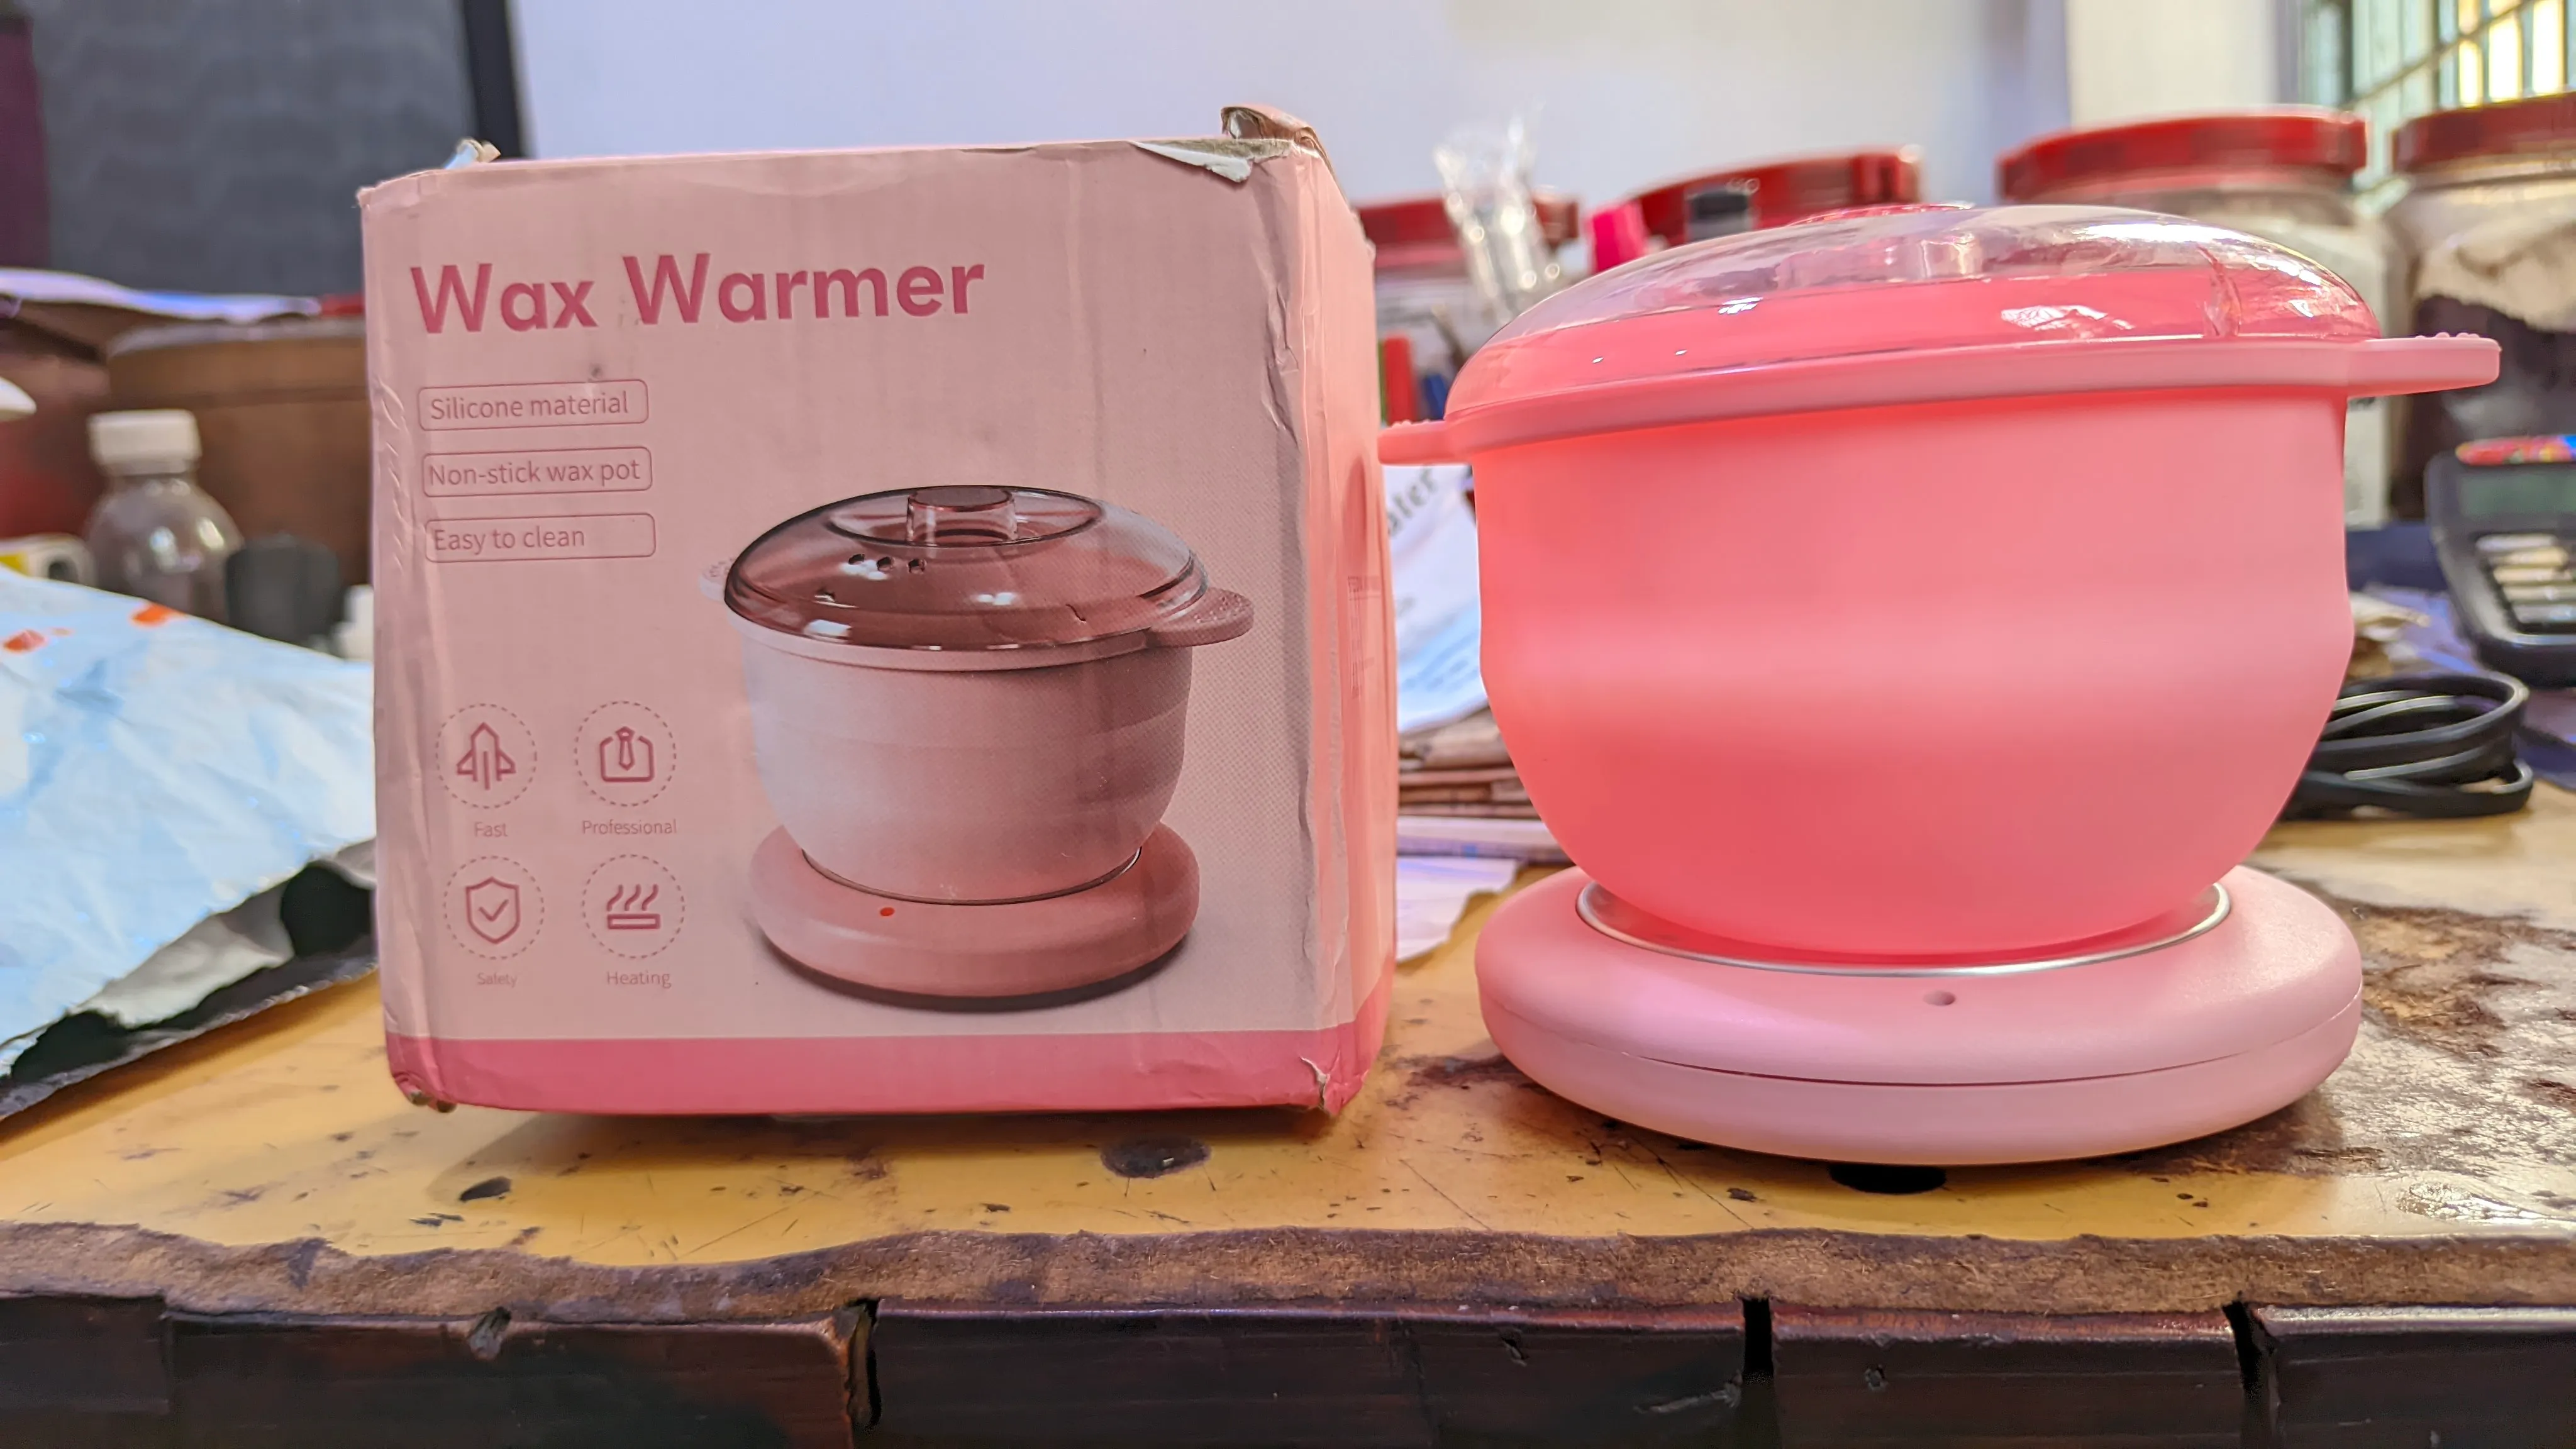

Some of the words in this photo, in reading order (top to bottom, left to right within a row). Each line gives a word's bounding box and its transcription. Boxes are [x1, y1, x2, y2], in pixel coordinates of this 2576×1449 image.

[410, 264, 597, 333] Wax
[623, 253, 984, 325] Warmer
[430, 397, 523, 420] Silicone
[530, 391, 628, 416] material
[428, 461, 541, 486] Non-stick
[547, 466, 594, 482] wax
[601, 460, 641, 487] pot
[434, 528, 486, 554] Easy
[493, 529, 516, 549] to
[523, 525, 585, 548] clean
[474, 822, 508, 837] Fast
[582, 819, 677, 835] Professional
[477, 972, 518, 988] Safety
[607, 971, 672, 989] Heating
